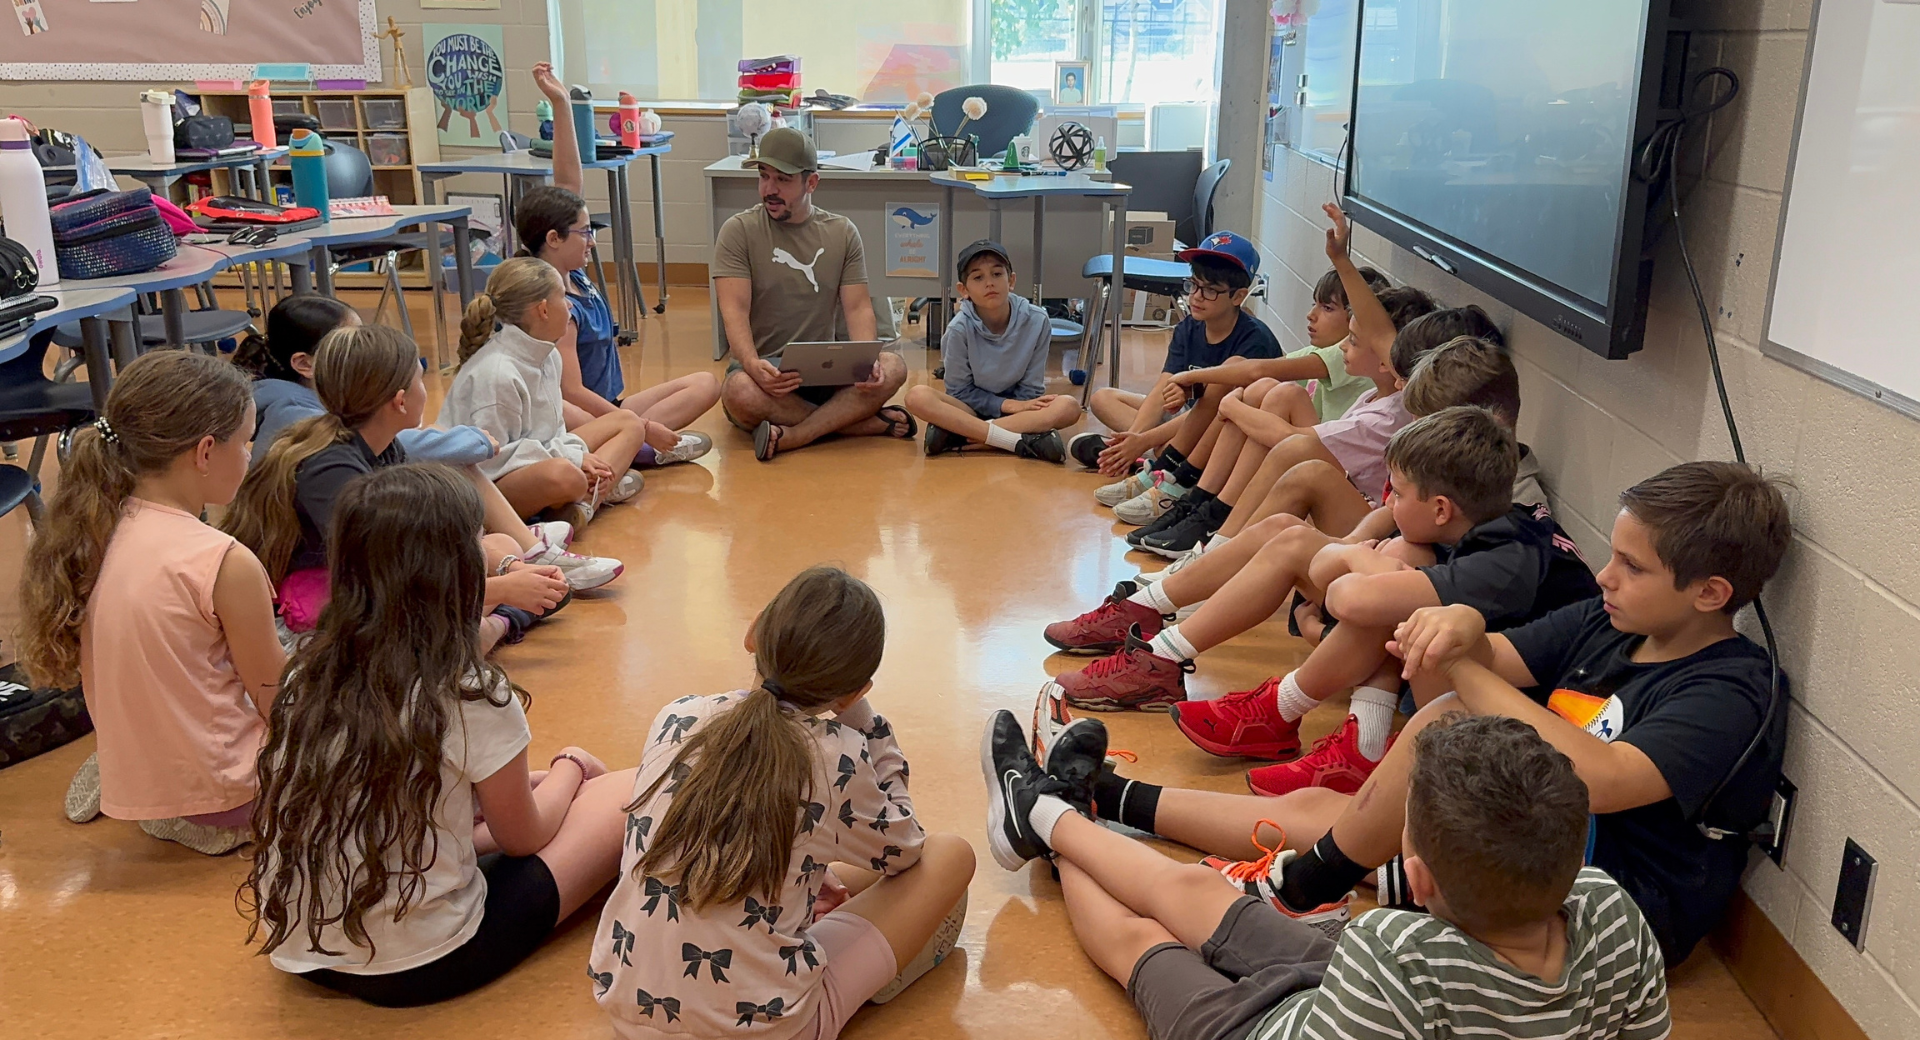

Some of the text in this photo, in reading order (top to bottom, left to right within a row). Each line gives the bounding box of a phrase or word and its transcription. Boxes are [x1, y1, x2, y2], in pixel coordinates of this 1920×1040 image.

[433, 36, 497, 59] YOU MUST BE THE
[428, 54, 502, 84] CHANGE
[437, 70, 497, 90] YOU WISH
[463, 79, 496, 95] THE
[438, 93, 494, 112] WORLD
